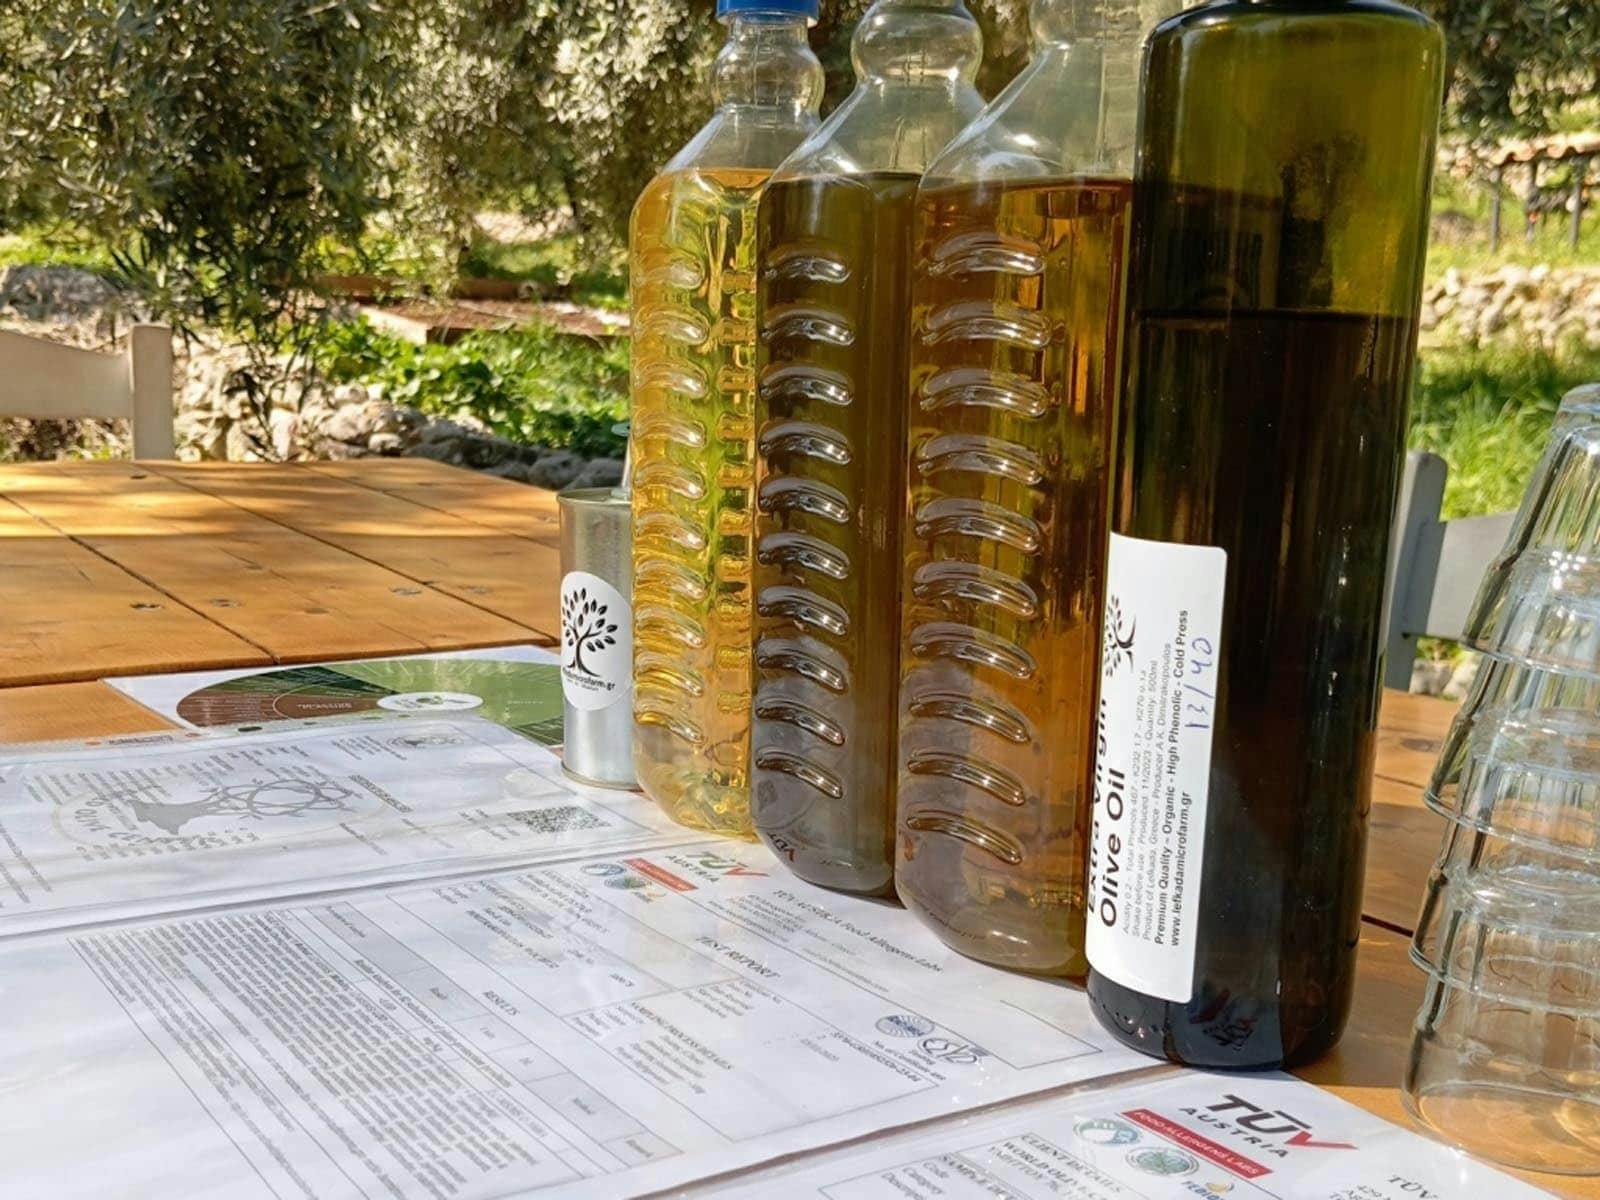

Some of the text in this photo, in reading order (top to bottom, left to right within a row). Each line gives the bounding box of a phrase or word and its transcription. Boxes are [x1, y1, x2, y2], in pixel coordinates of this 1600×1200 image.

[1175, 610, 1189, 646] Press
[1148, 659, 1158, 693] 500ml
[1173, 648, 1186, 679] Cold
[1168, 689, 1182, 743] Phenolic
[1152, 753, 1164, 799] Producer
[1166, 745, 1179, 775] High
[1128, 807, 1138, 846] Phenols
[1149, 808, 1159, 845] Greece
[1162, 786, 1176, 835] Organic
[1100, 767, 1125, 928] Olive Oil
[1126, 848, 1134, 872] Total
[665, 854, 720, 883] AUSTRIA
[1158, 846, 1172, 890] Quality
[1171, 791, 1192, 947] www.lefkadamicrofarm.gr
[1134, 873, 1144, 905] before
[1145, 889, 1154, 901] of
[1132, 905, 1141, 937] Shake
[1143, 902, 1154, 941] Product
[1154, 892, 1168, 945] Premium
[695, 935, 732, 952] TEST
[725, 949, 782, 979] REPORT
[1178, 1107, 1291, 1159] AUSTRIA
[1206, 1093, 1360, 1151] TÜV
[1226, 1156, 1260, 1175] LABS
